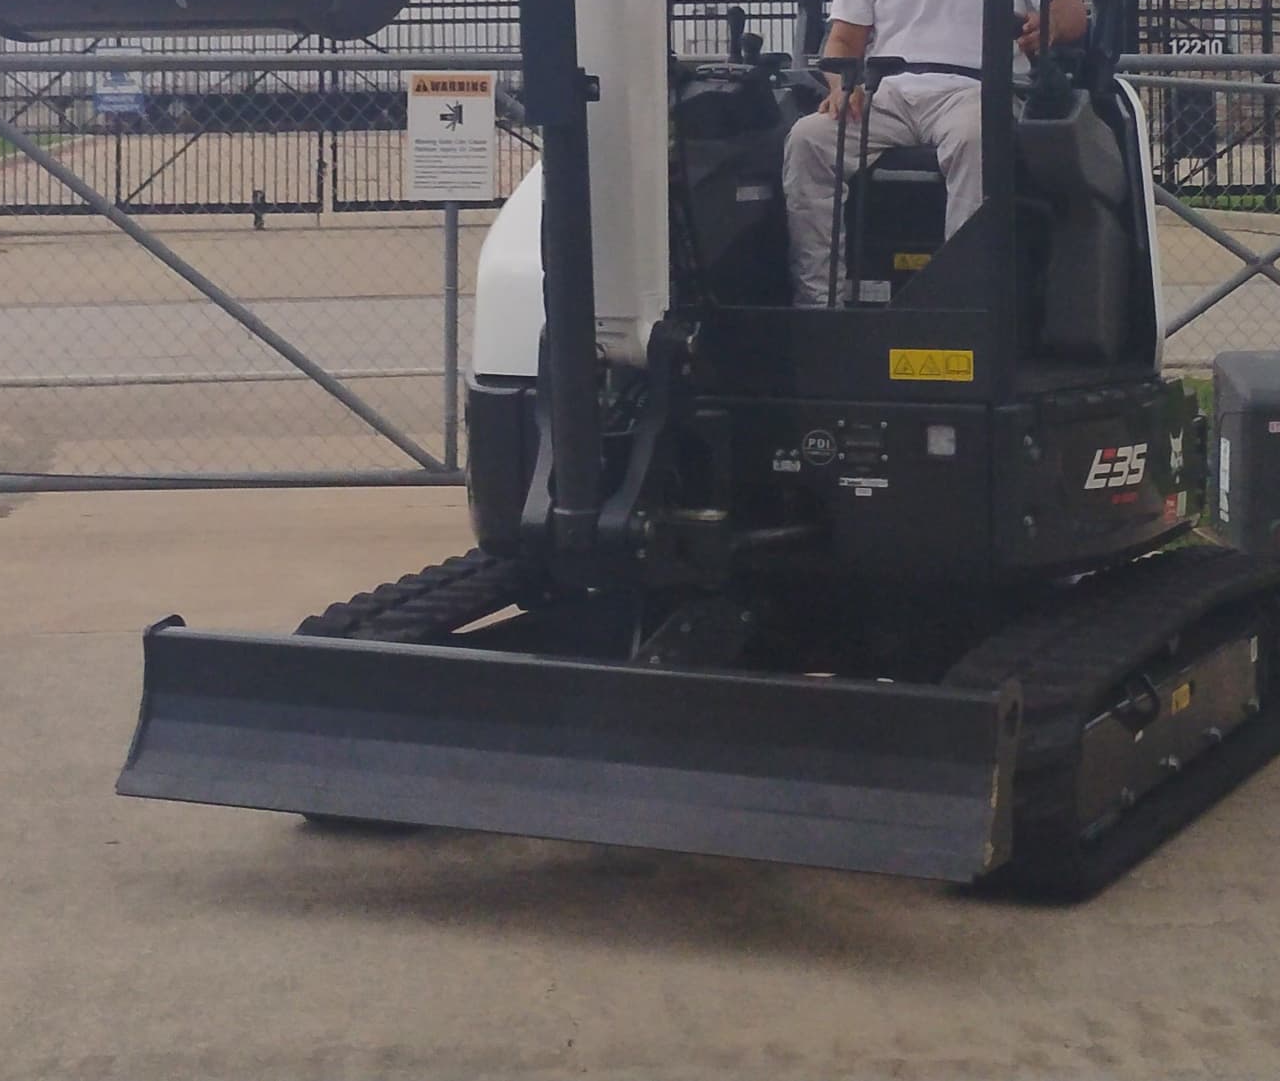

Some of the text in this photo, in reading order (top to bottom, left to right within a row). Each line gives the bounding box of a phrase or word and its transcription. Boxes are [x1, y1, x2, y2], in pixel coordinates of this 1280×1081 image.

[1168, 38, 1223, 57] 12210
[808, 438, 830, 449] PDI
[1084, 443, 1147, 489] E35
